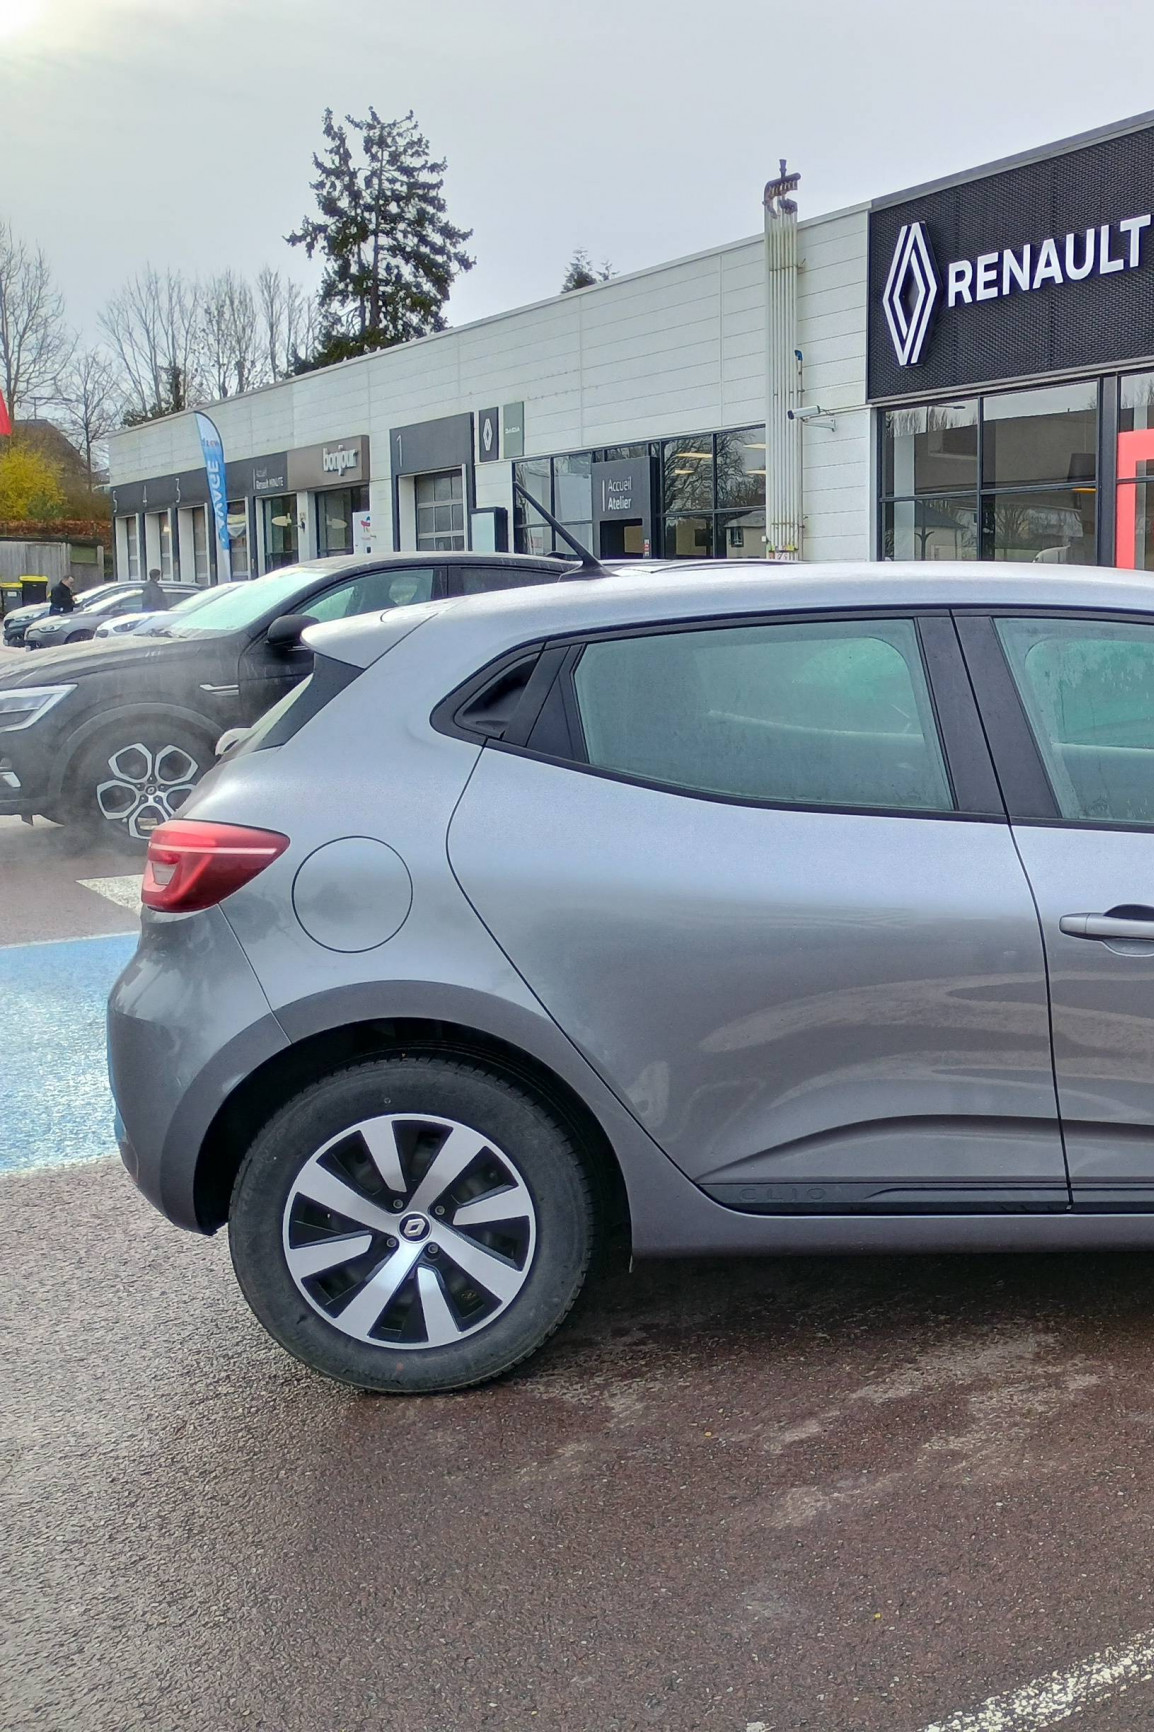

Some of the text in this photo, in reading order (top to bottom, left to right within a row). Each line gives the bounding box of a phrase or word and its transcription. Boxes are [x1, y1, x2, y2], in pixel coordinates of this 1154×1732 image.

[948, 214, 1151, 308] RENAULT
[607, 476, 632, 492] Accueil
[607, 496, 632, 510] Atelier
